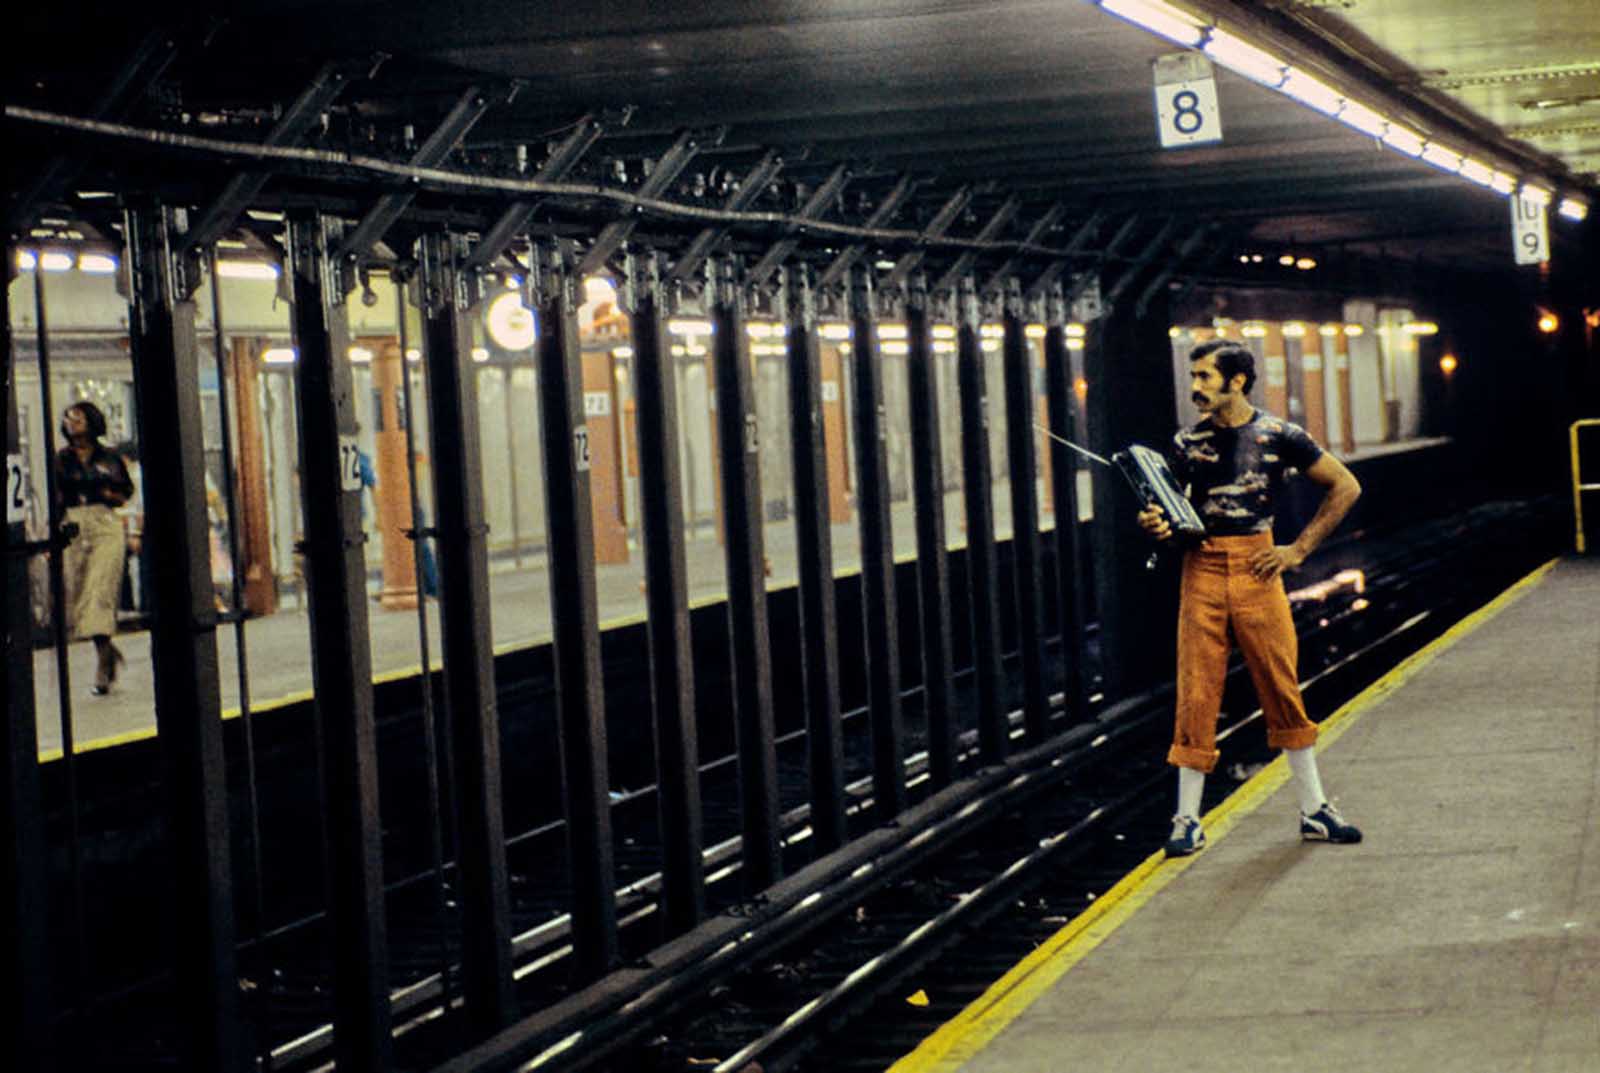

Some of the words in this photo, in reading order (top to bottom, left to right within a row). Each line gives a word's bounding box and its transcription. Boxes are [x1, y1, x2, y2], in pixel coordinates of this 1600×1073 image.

[1173, 91, 1202, 134] 8
[1522, 232, 1539, 255] 9
[342, 445, 360, 480] 72
[576, 433, 589, 461] 72
[7, 464, 24, 508] 2
